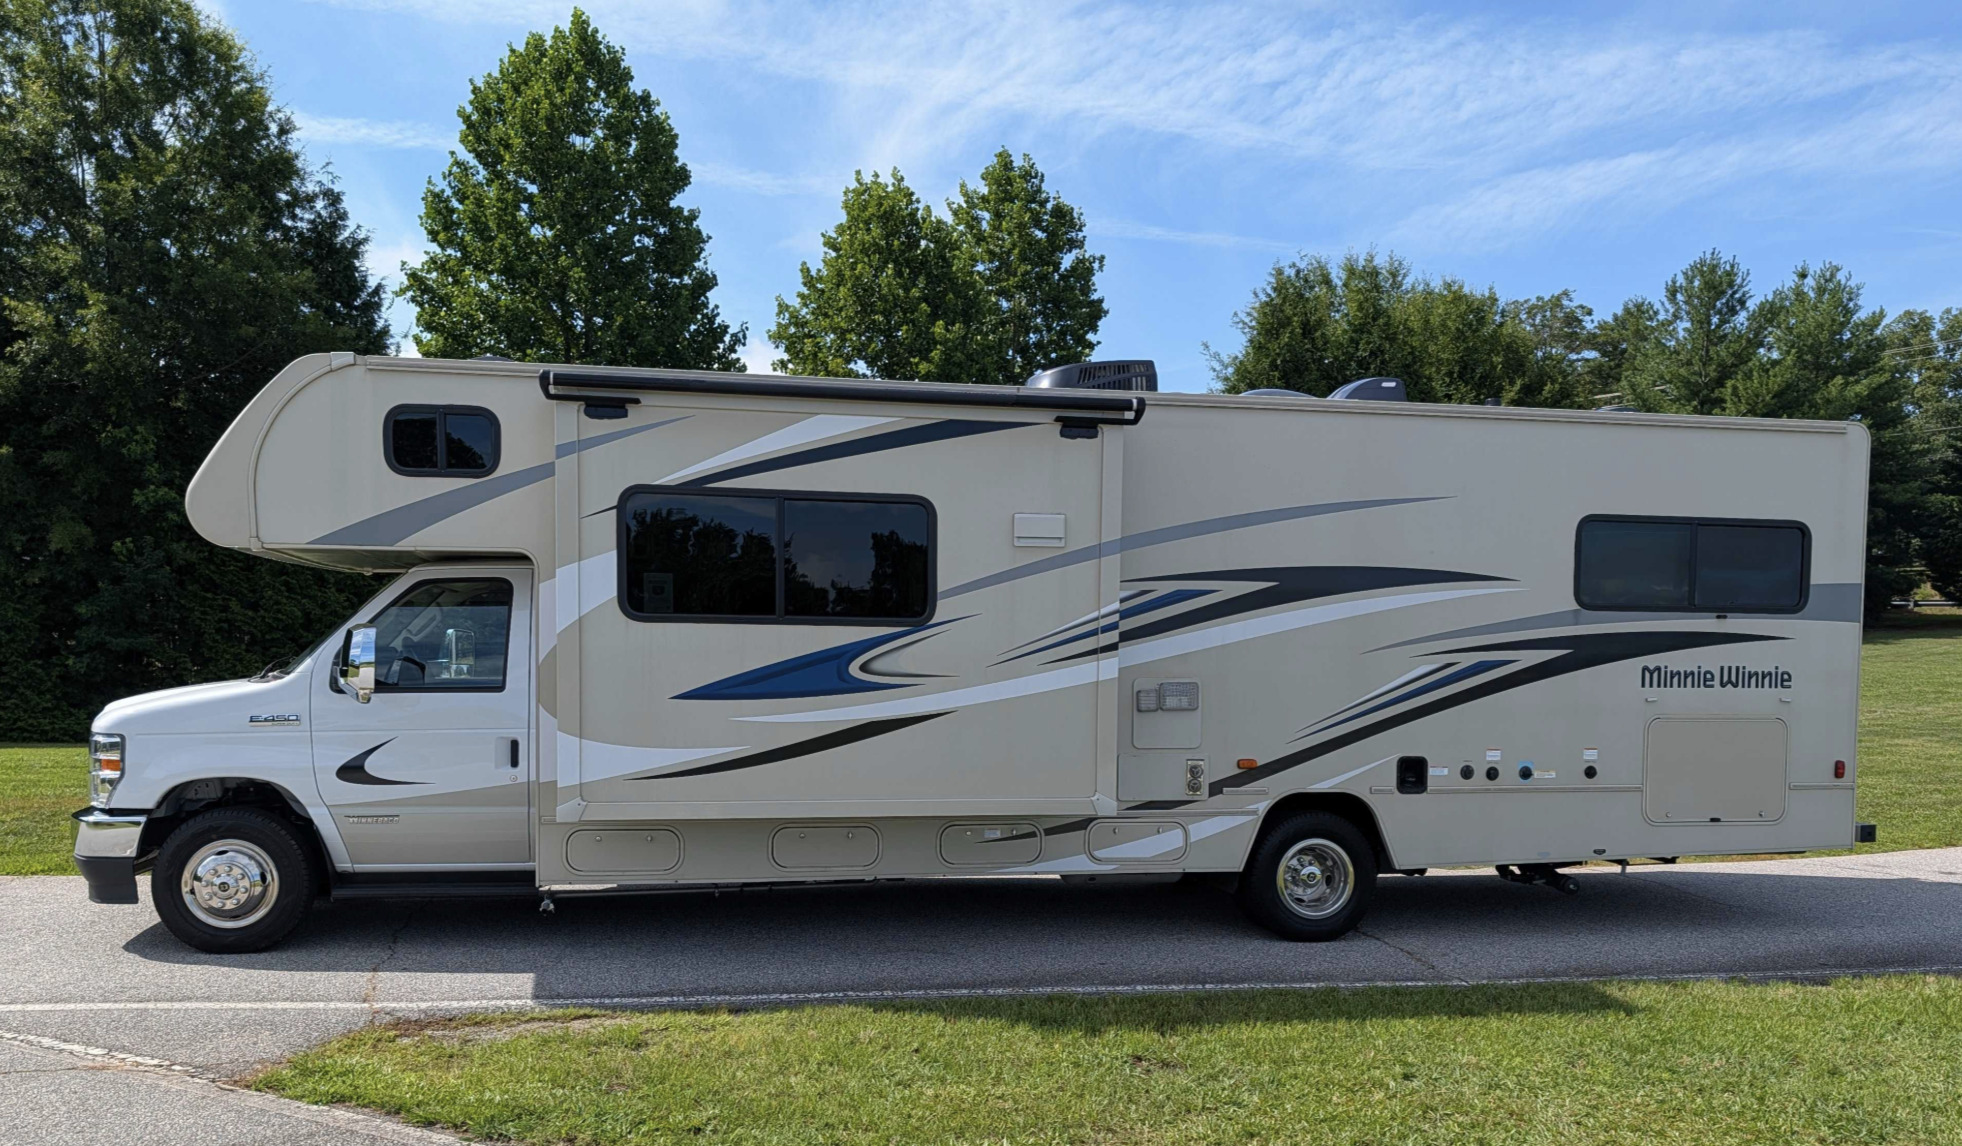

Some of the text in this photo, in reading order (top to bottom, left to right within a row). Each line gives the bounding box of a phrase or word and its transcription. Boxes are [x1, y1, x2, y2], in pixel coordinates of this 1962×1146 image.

[1641, 665, 1792, 689] Minnie Winnie
[249, 714, 300, 722] E-450
